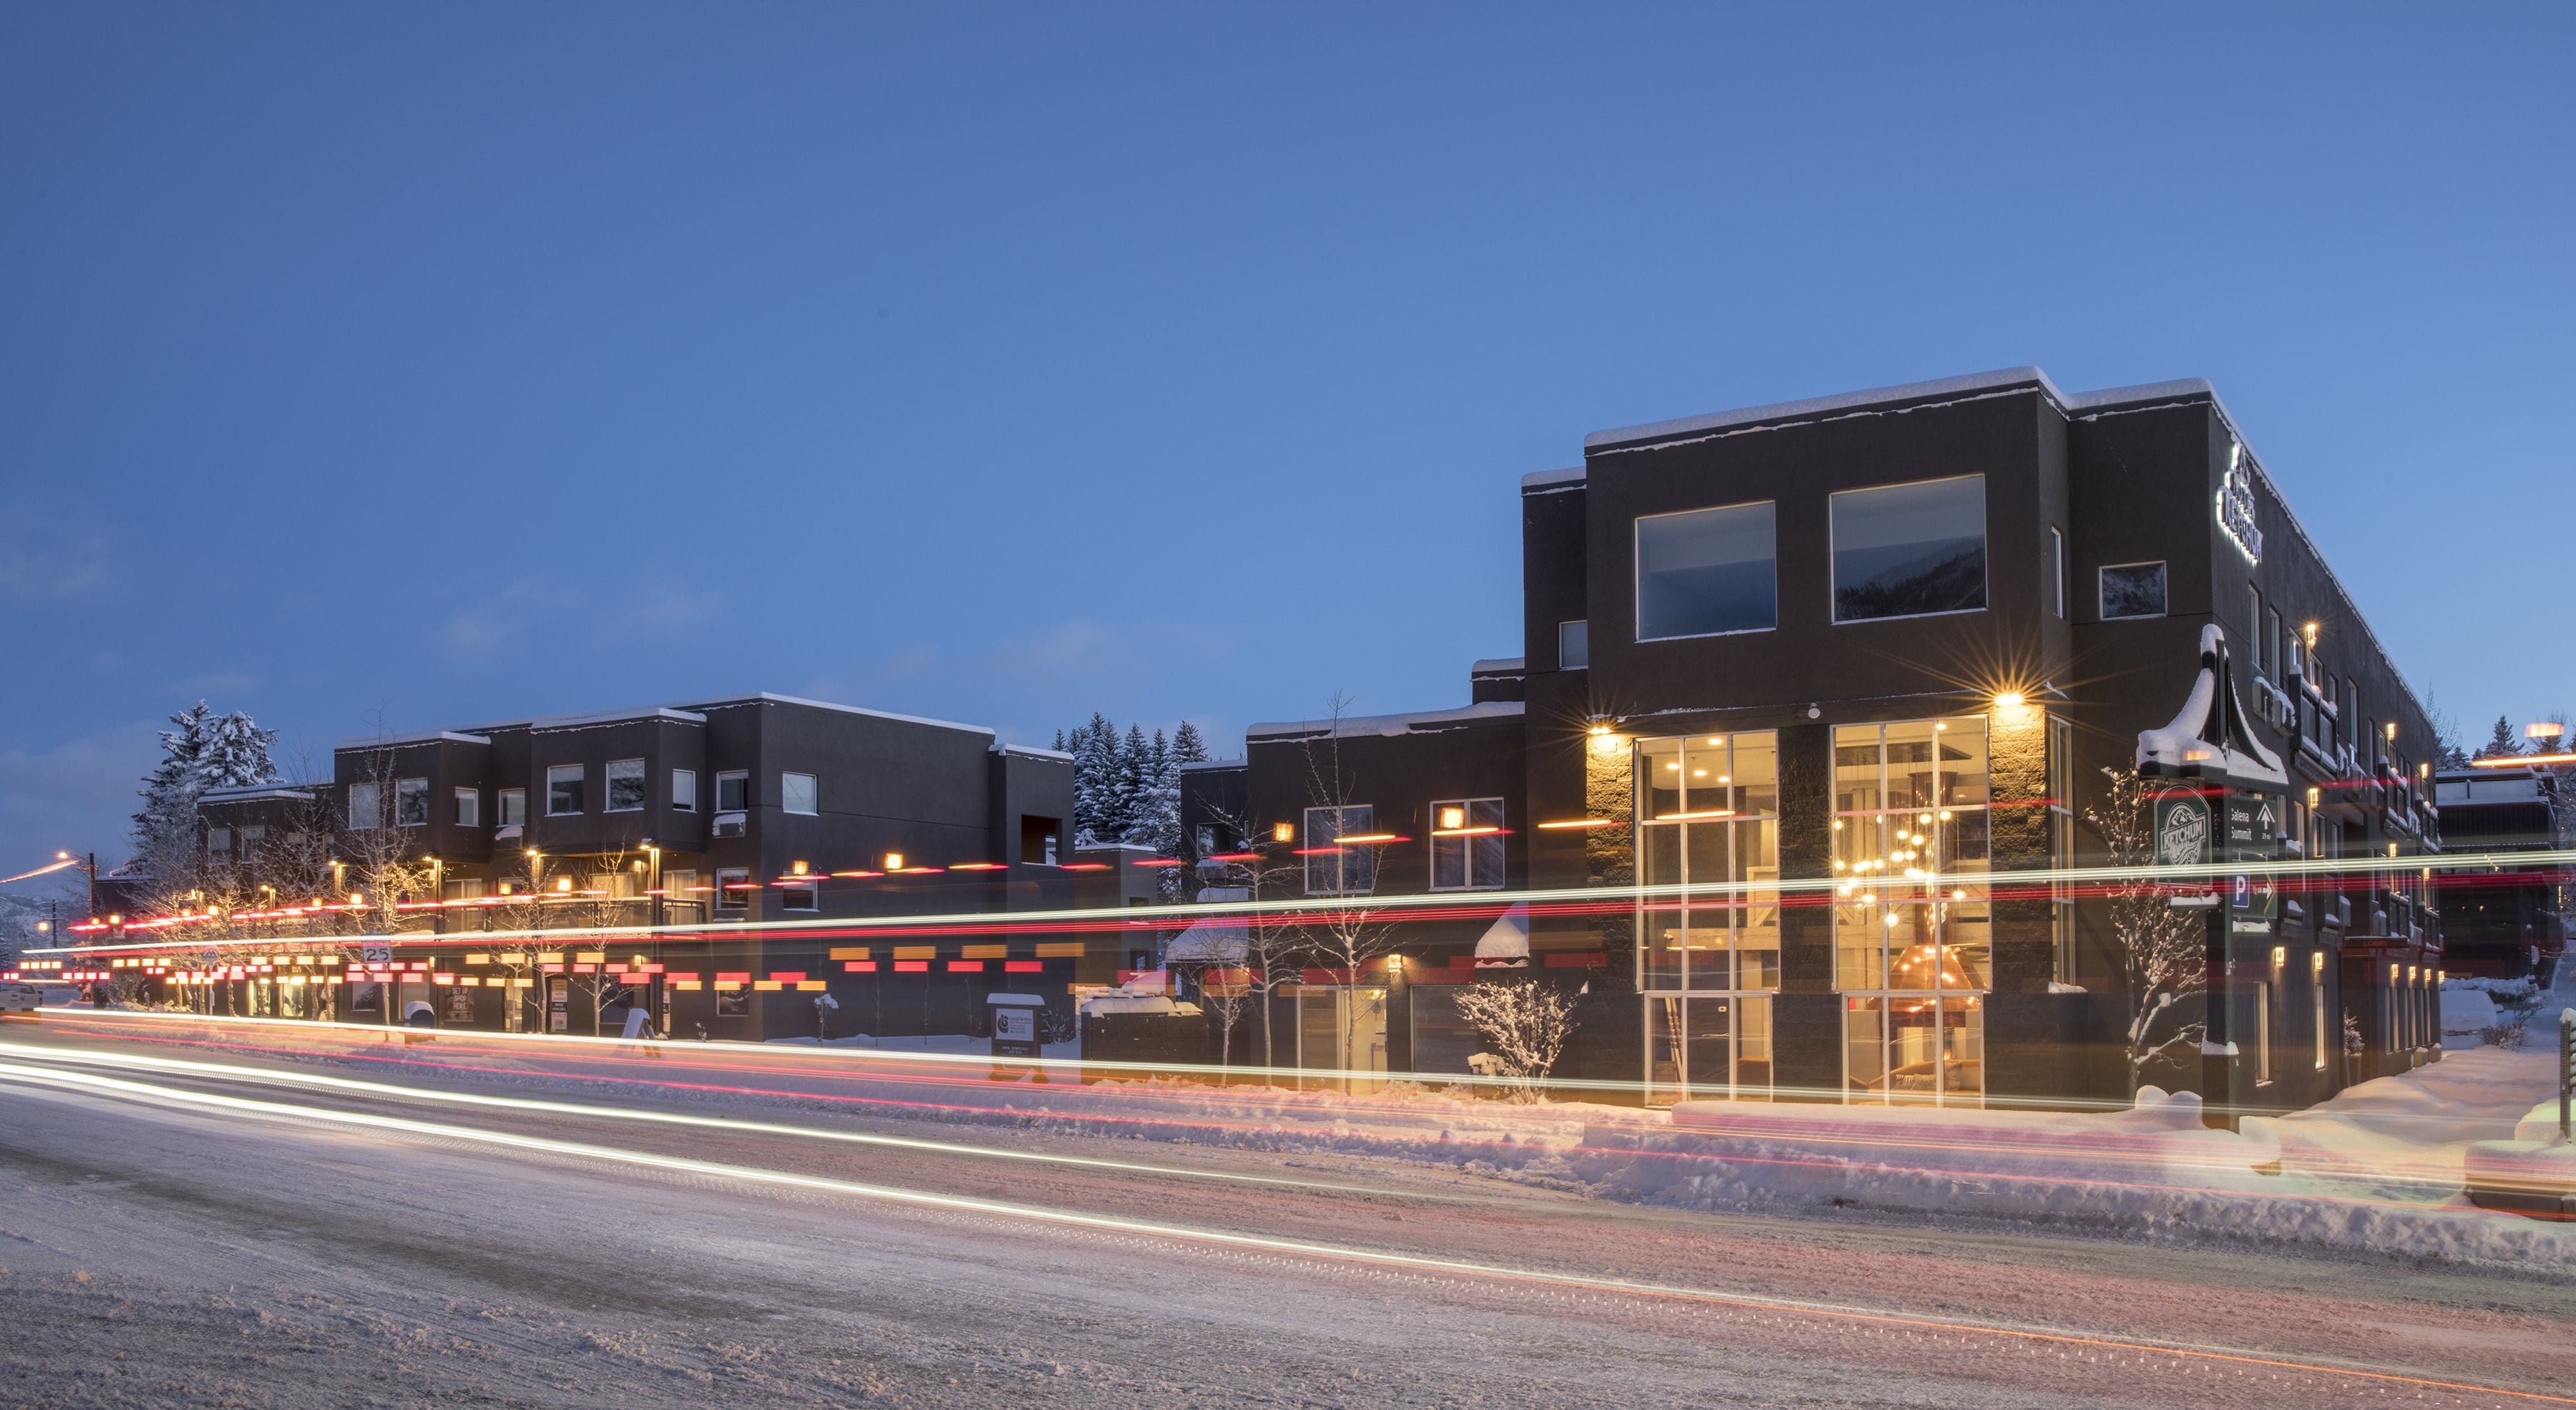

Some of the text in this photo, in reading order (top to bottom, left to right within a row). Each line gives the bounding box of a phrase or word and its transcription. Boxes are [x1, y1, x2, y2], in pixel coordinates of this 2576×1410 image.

[2219, 487, 2263, 563] KETCHUM
[2163, 820, 2202, 849] KETCHUM
[2235, 875, 2246, 901] P
[366, 948, 389, 961] 25
